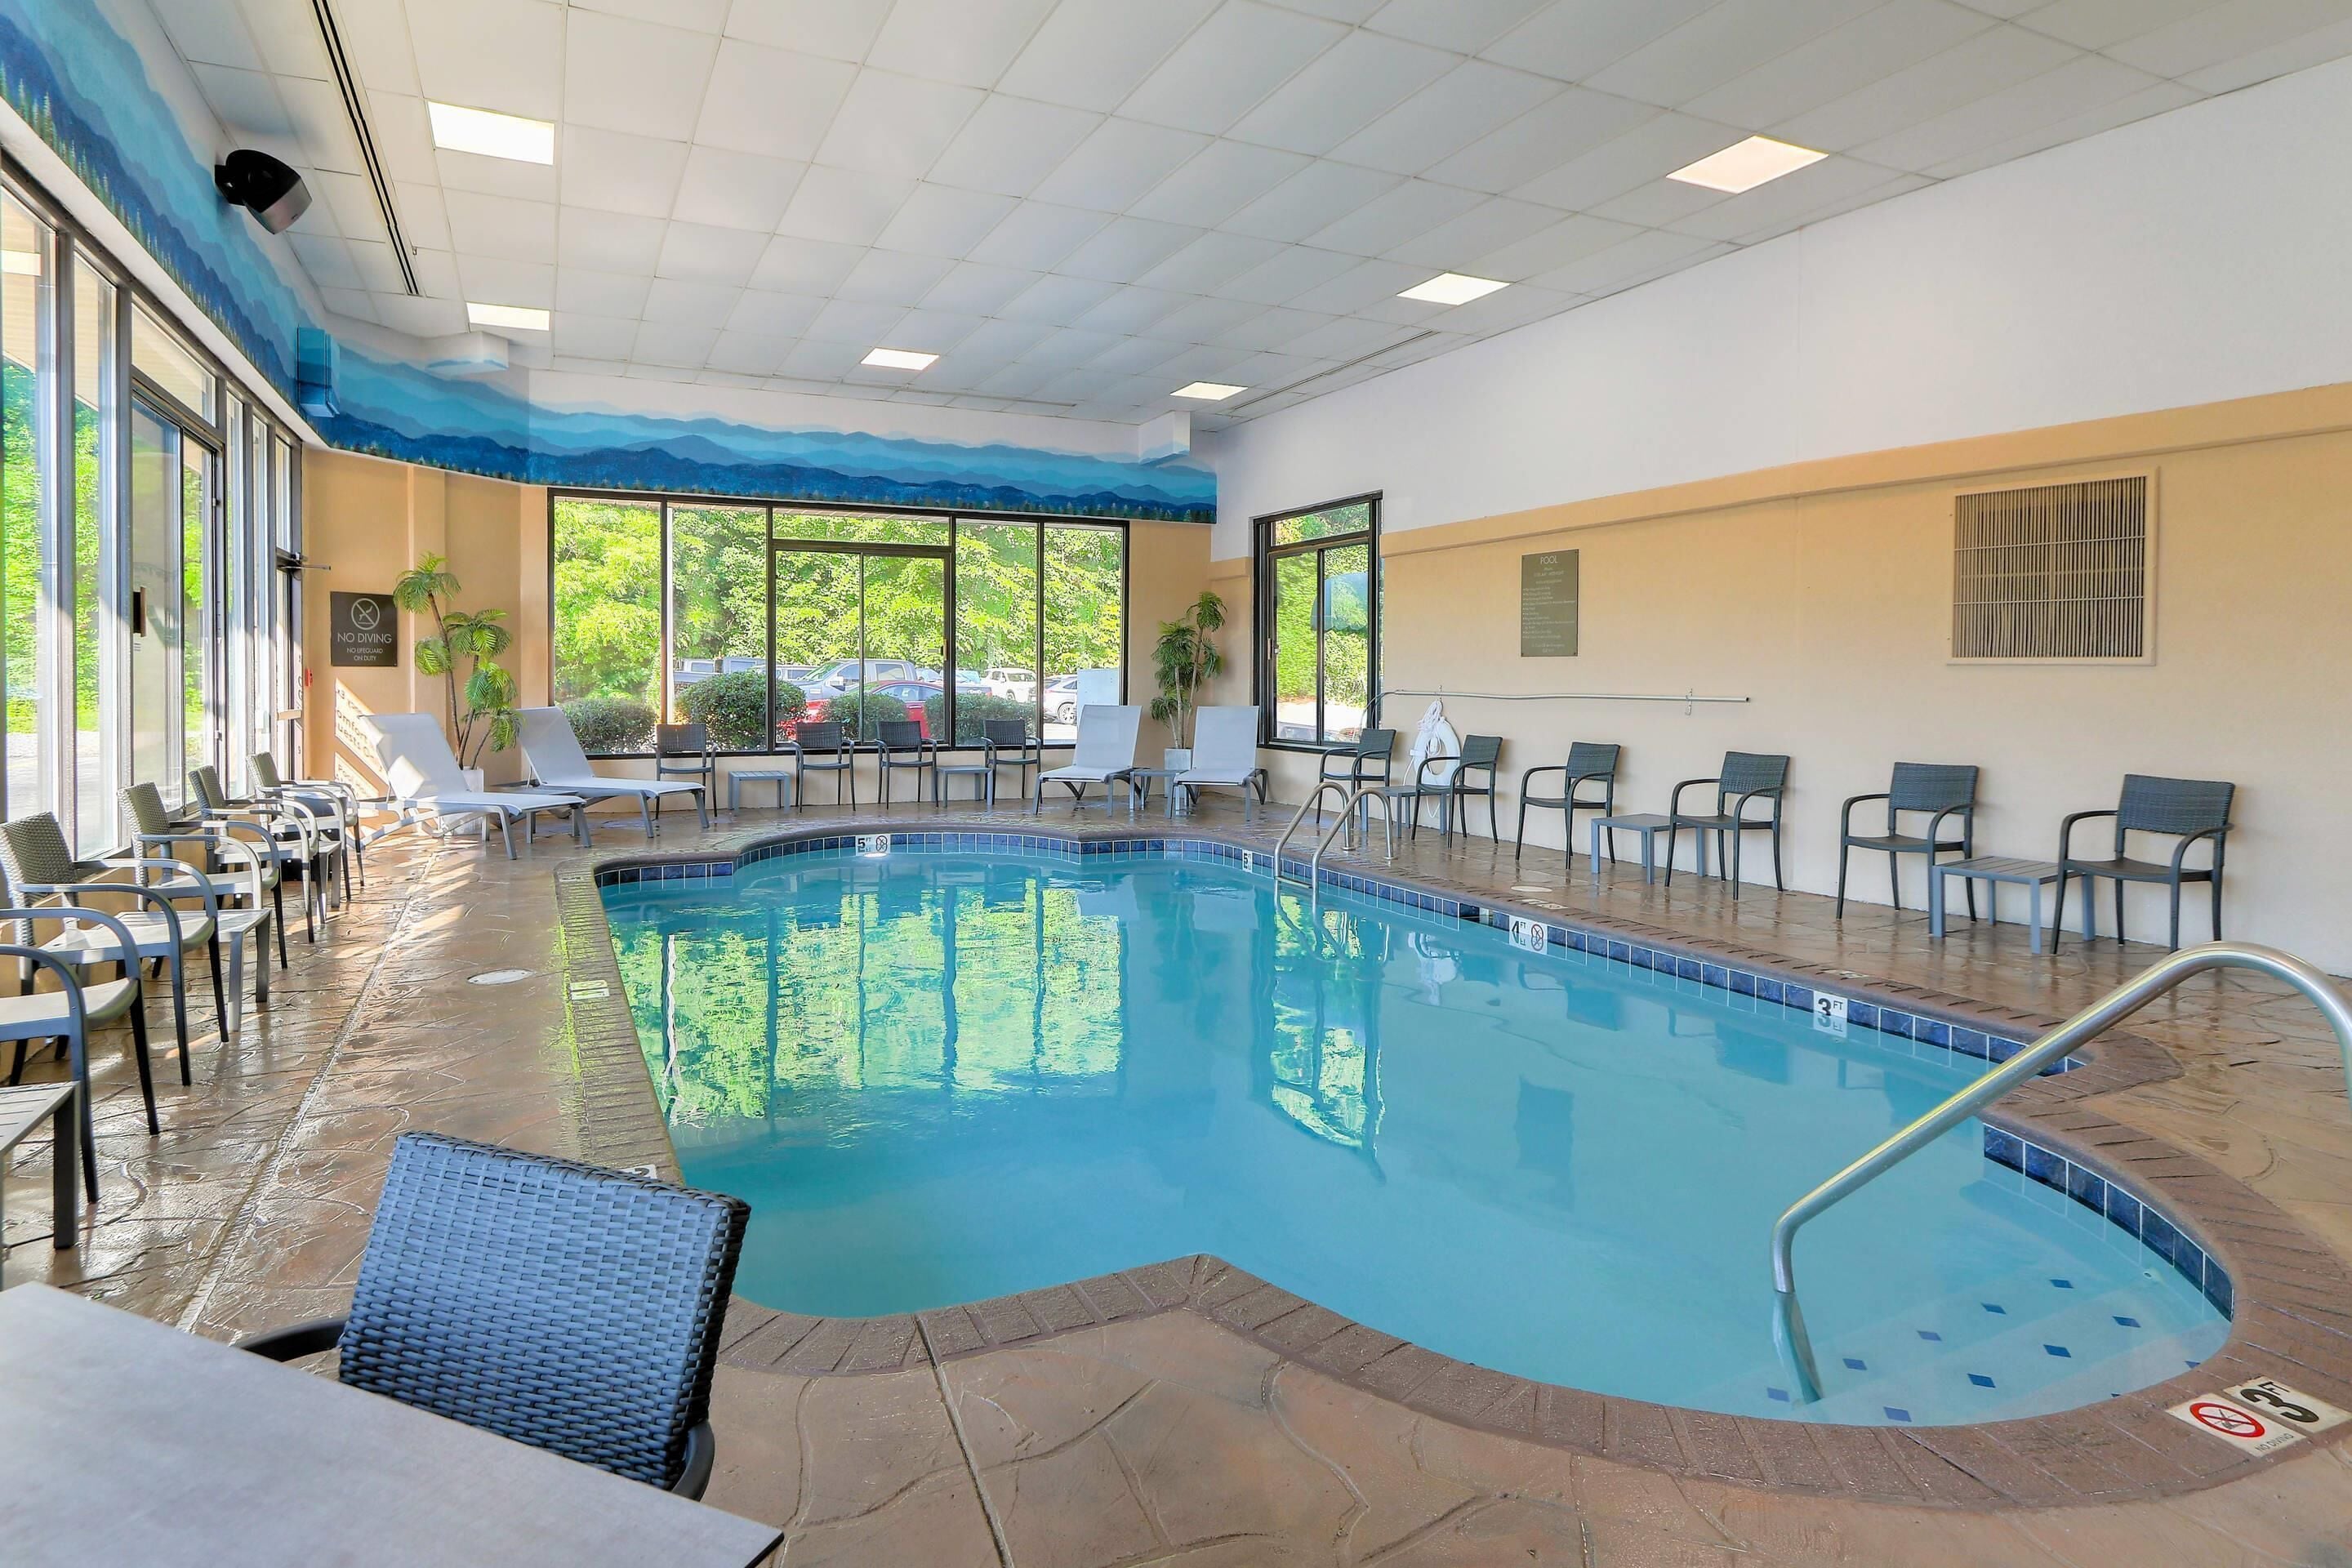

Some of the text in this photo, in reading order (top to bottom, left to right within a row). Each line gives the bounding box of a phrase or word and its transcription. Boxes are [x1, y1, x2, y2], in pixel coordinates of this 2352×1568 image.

[1540, 555, 1558, 564] POOL
[337, 632, 392, 644] NO DIVING
[1818, 998, 1844, 1016] 3 FT
[2239, 1381, 2319, 1423] 3 FT
[2254, 1432, 2294, 1452] NO DIVING
